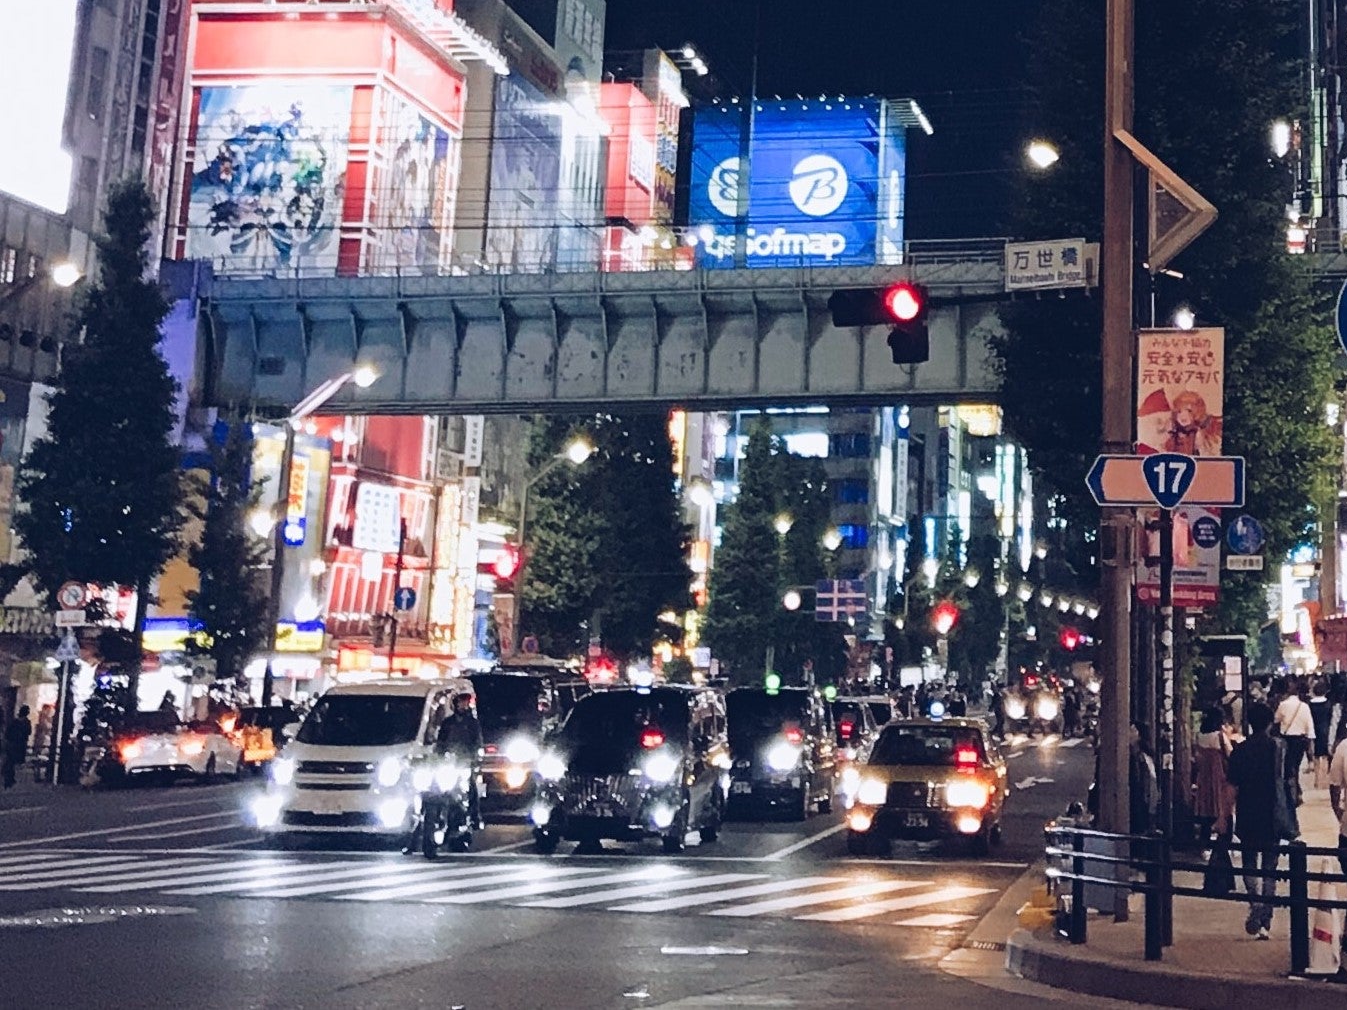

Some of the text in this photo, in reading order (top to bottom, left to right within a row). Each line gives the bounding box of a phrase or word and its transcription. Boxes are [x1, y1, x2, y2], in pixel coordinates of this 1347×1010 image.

[1143, 369, 1221, 385] 元気なアキバ
[1152, 461, 1187, 495] 17
